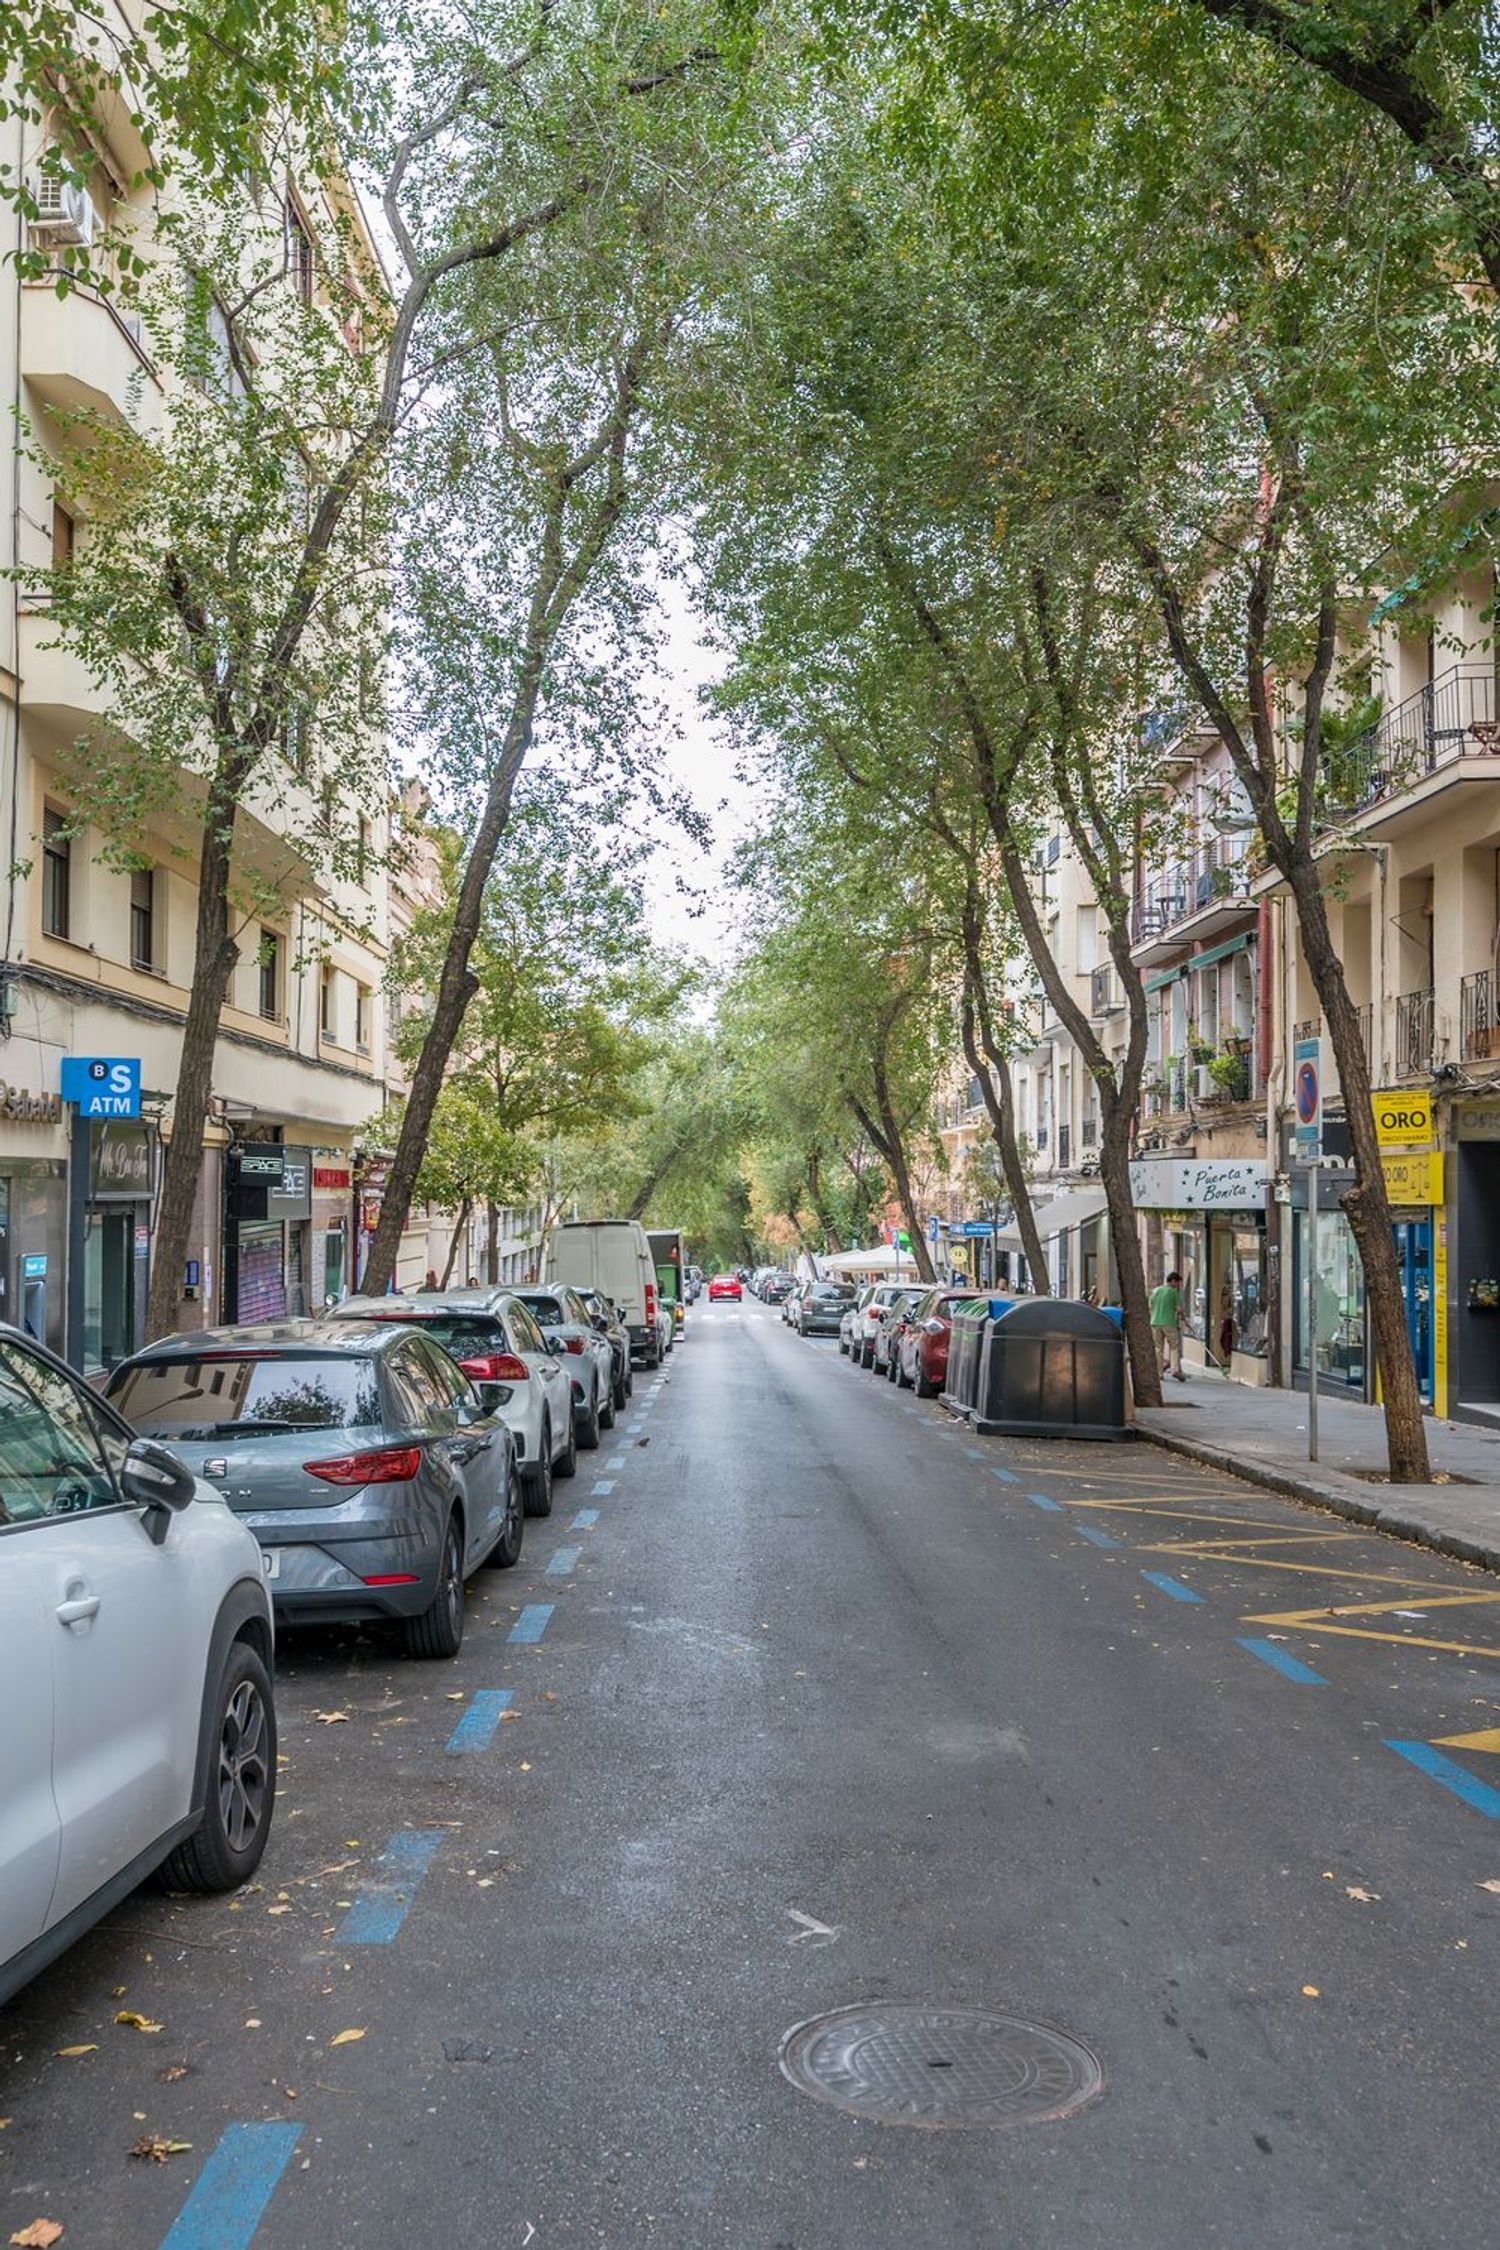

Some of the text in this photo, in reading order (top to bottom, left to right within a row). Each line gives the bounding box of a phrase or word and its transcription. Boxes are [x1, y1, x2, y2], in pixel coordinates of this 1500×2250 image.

[89, 1097, 130, 1113] ATM
[1381, 1111, 1426, 1129] ORO
[1195, 1168, 1240, 1186] Puerta
[1203, 1185, 1246, 1202] Bonita
